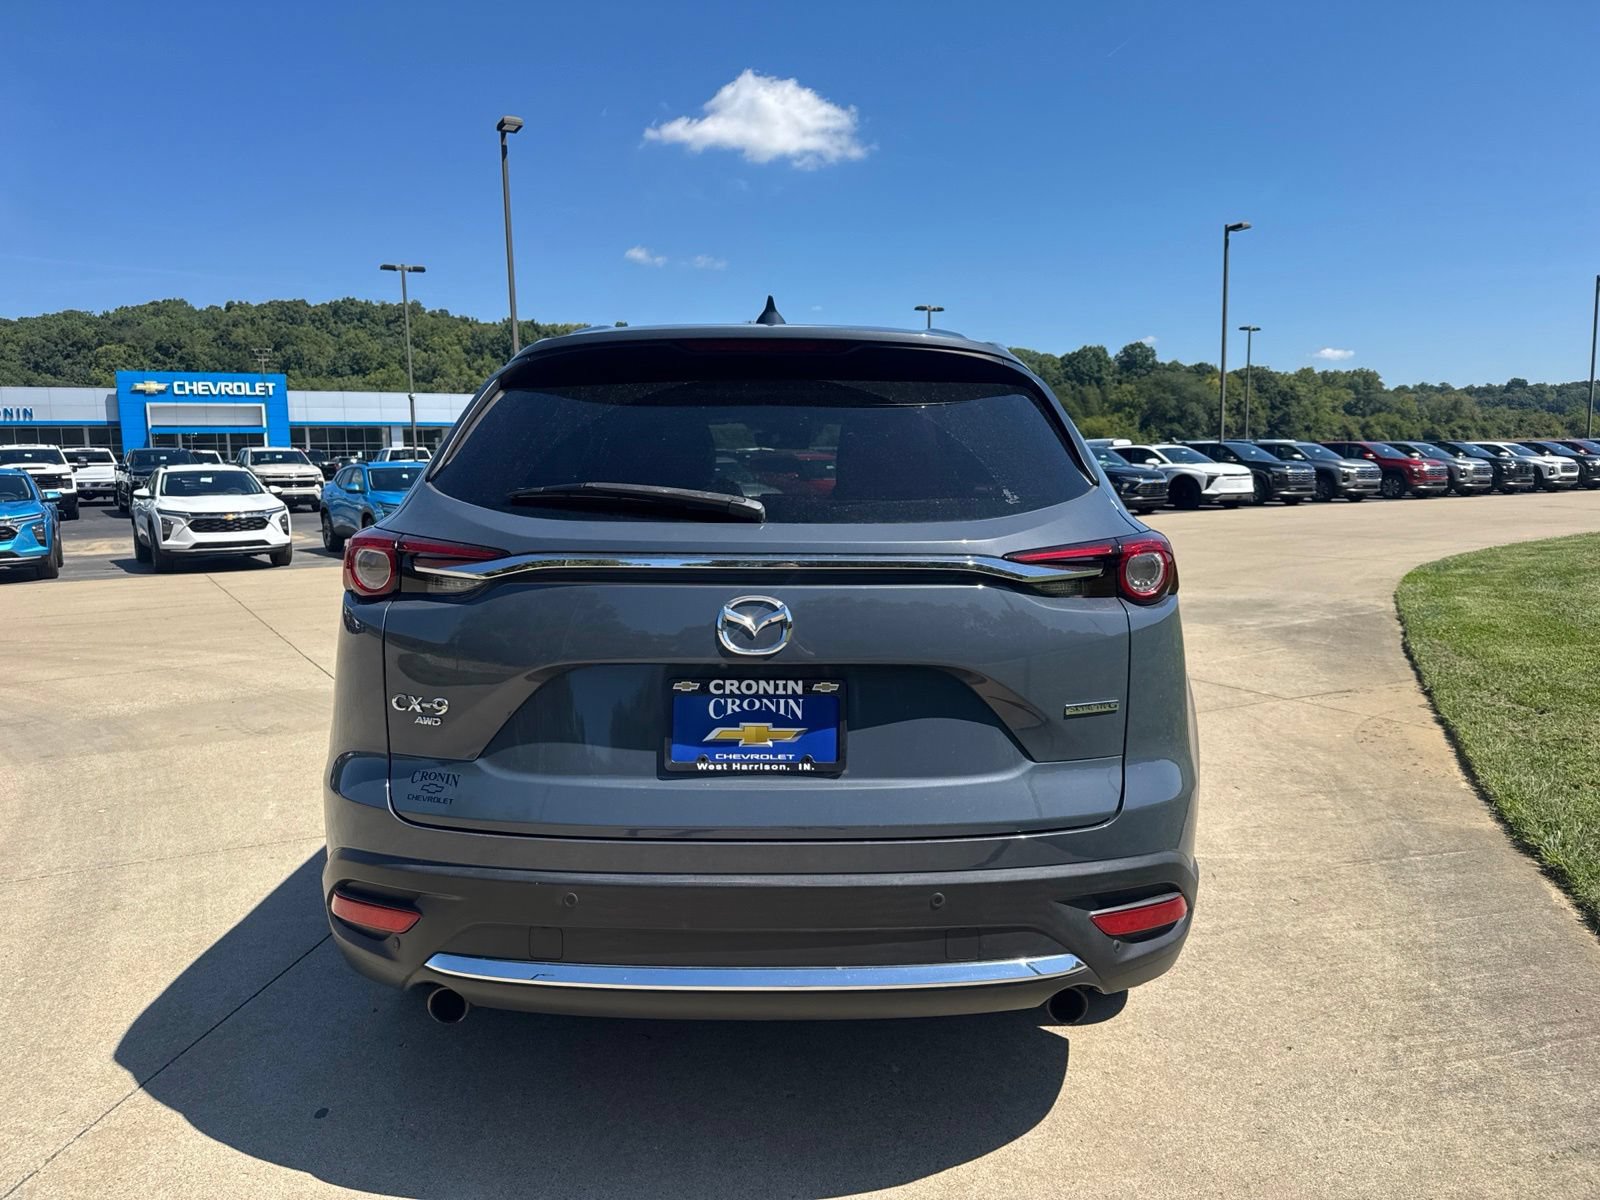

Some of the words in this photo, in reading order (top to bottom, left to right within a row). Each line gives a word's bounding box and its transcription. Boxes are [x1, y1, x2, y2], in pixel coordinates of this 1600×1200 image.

[172, 381, 276, 396] CHEVROLET
[0, 407, 33, 420] NIN
[708, 679, 804, 695] CRONIN
[391, 693, 449, 716] CX-9
[708, 697, 804, 721] CRONIN
[414, 716, 442, 727] AWD
[696, 763, 728, 771] West
[798, 763, 815, 771] IN.
[410, 770, 461, 788] CRONIN
[407, 793, 455, 805] CHEVROLET
